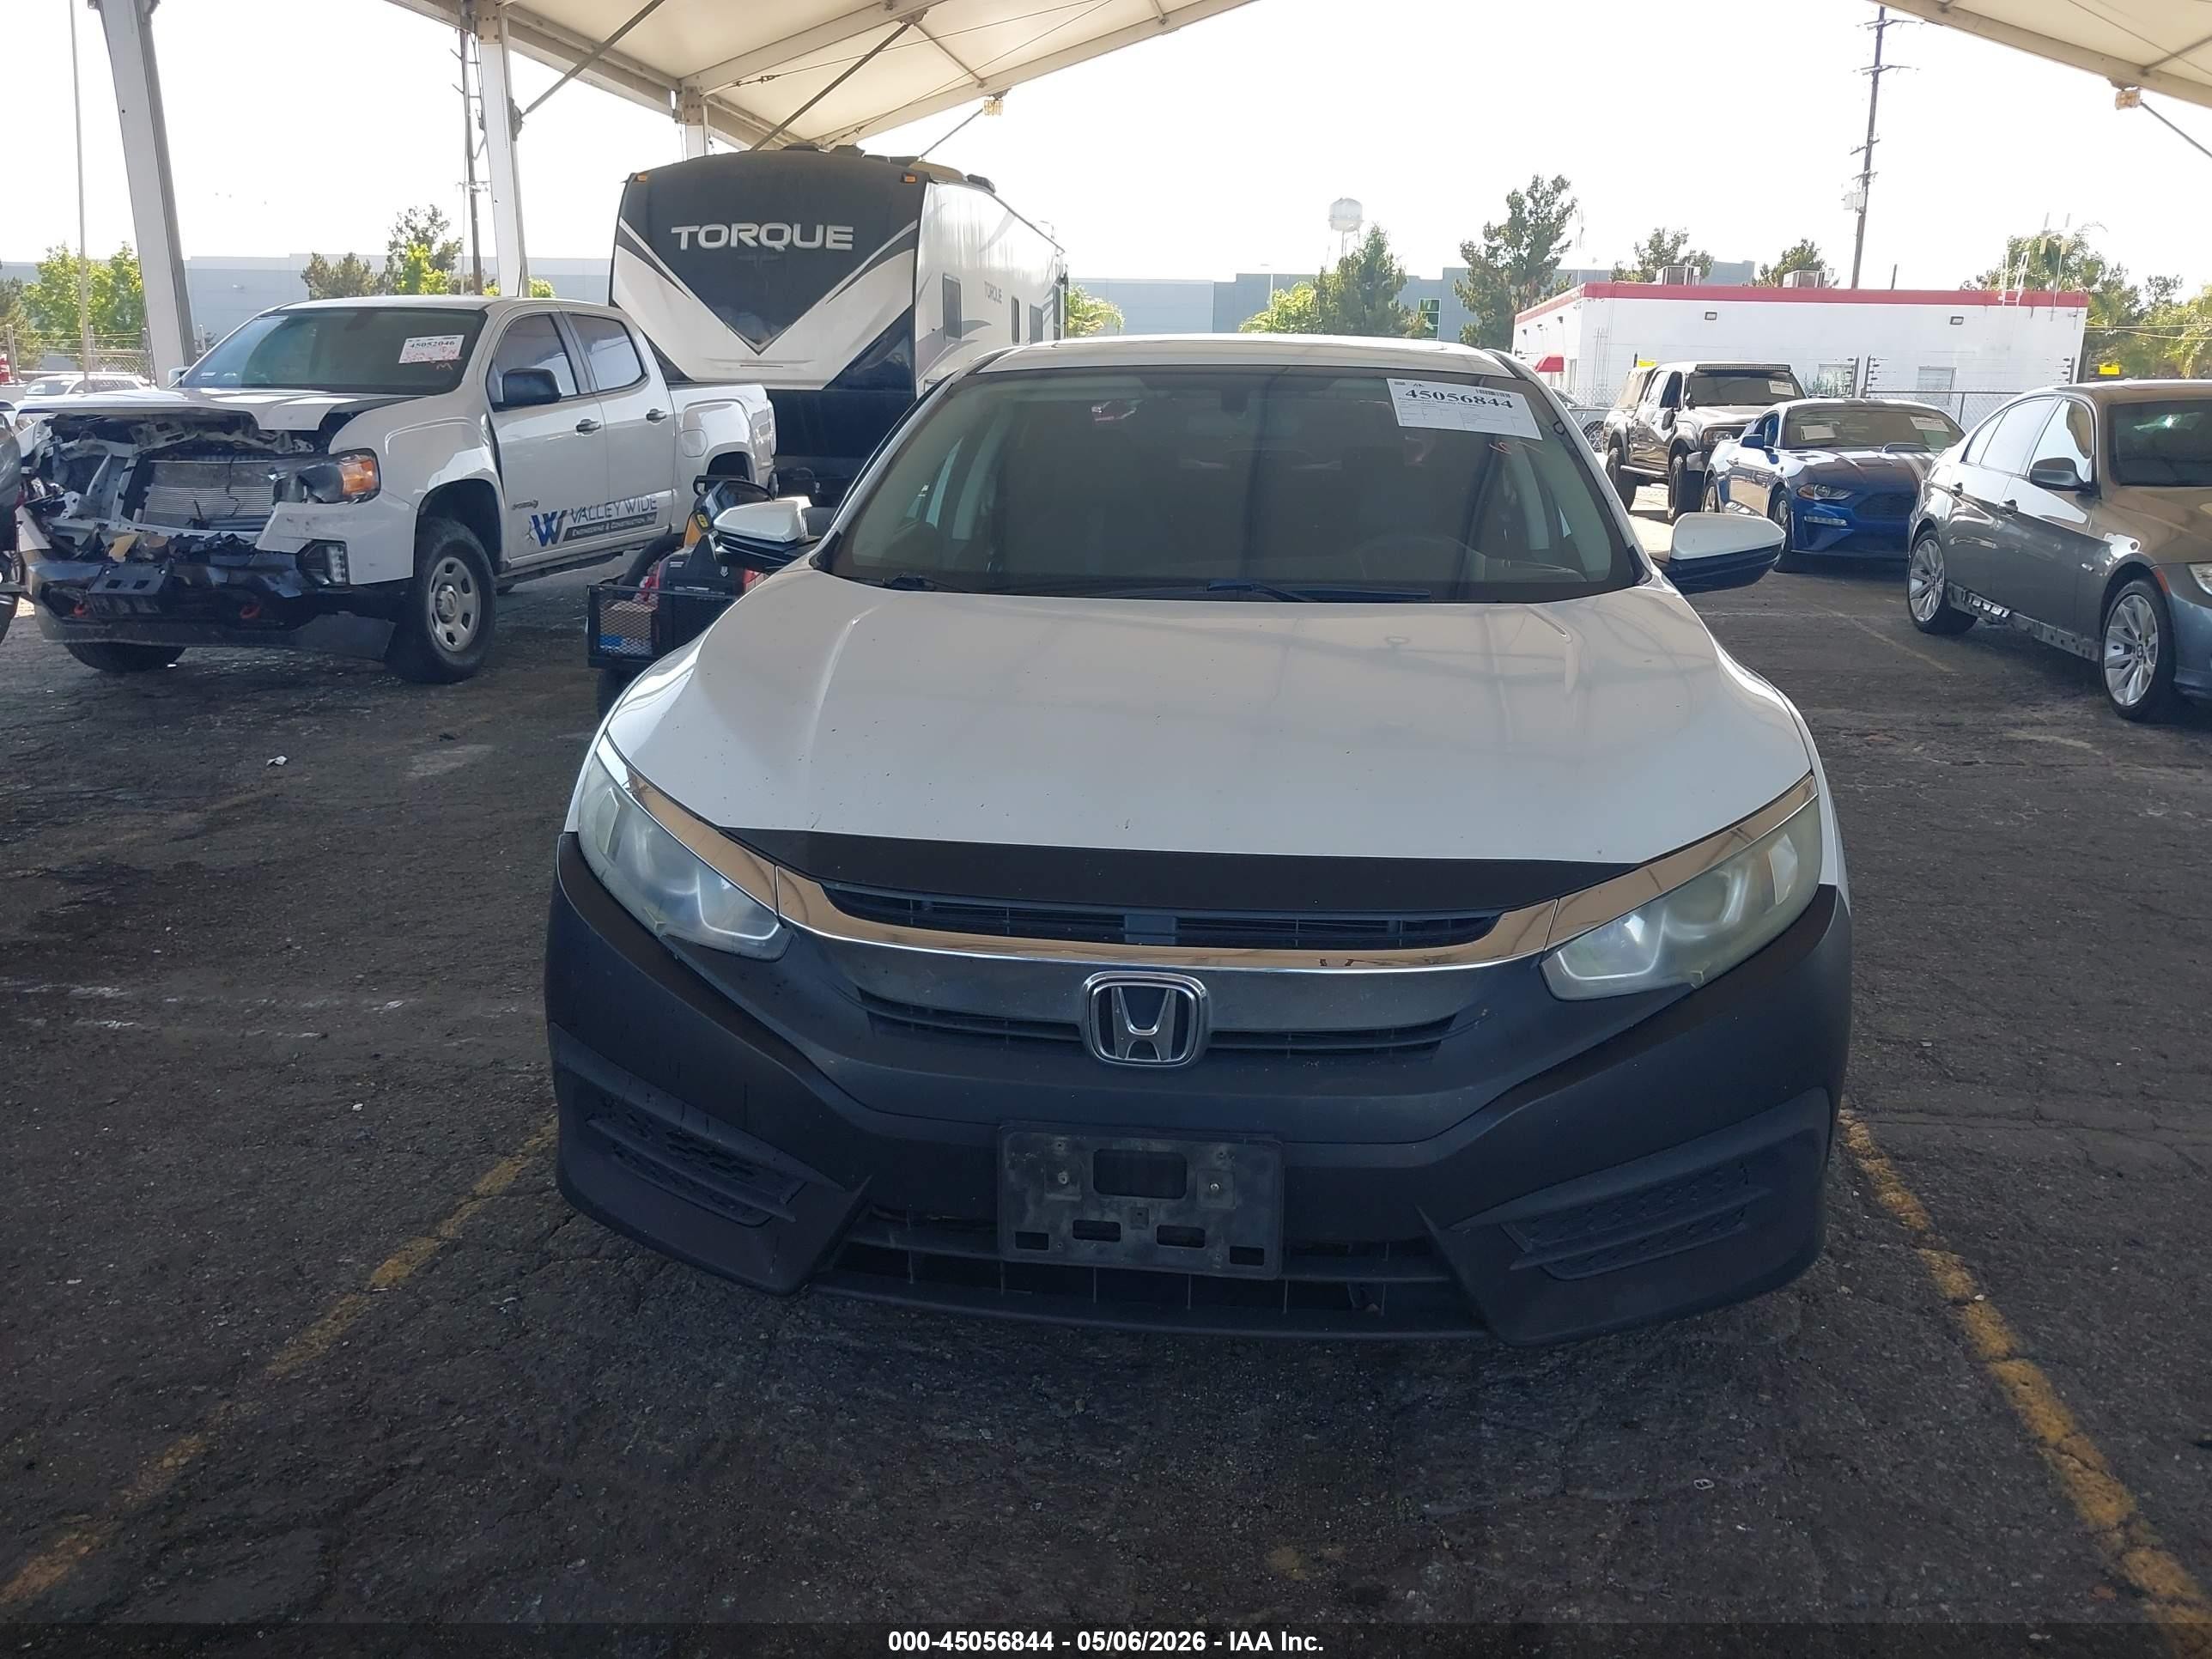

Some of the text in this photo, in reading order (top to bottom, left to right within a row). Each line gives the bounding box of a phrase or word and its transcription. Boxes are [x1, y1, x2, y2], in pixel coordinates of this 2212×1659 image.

[670, 222, 854, 252] TORQUE
[1405, 389, 1514, 409] 45056844
[571, 496, 658, 524] VALLEY WIDE
